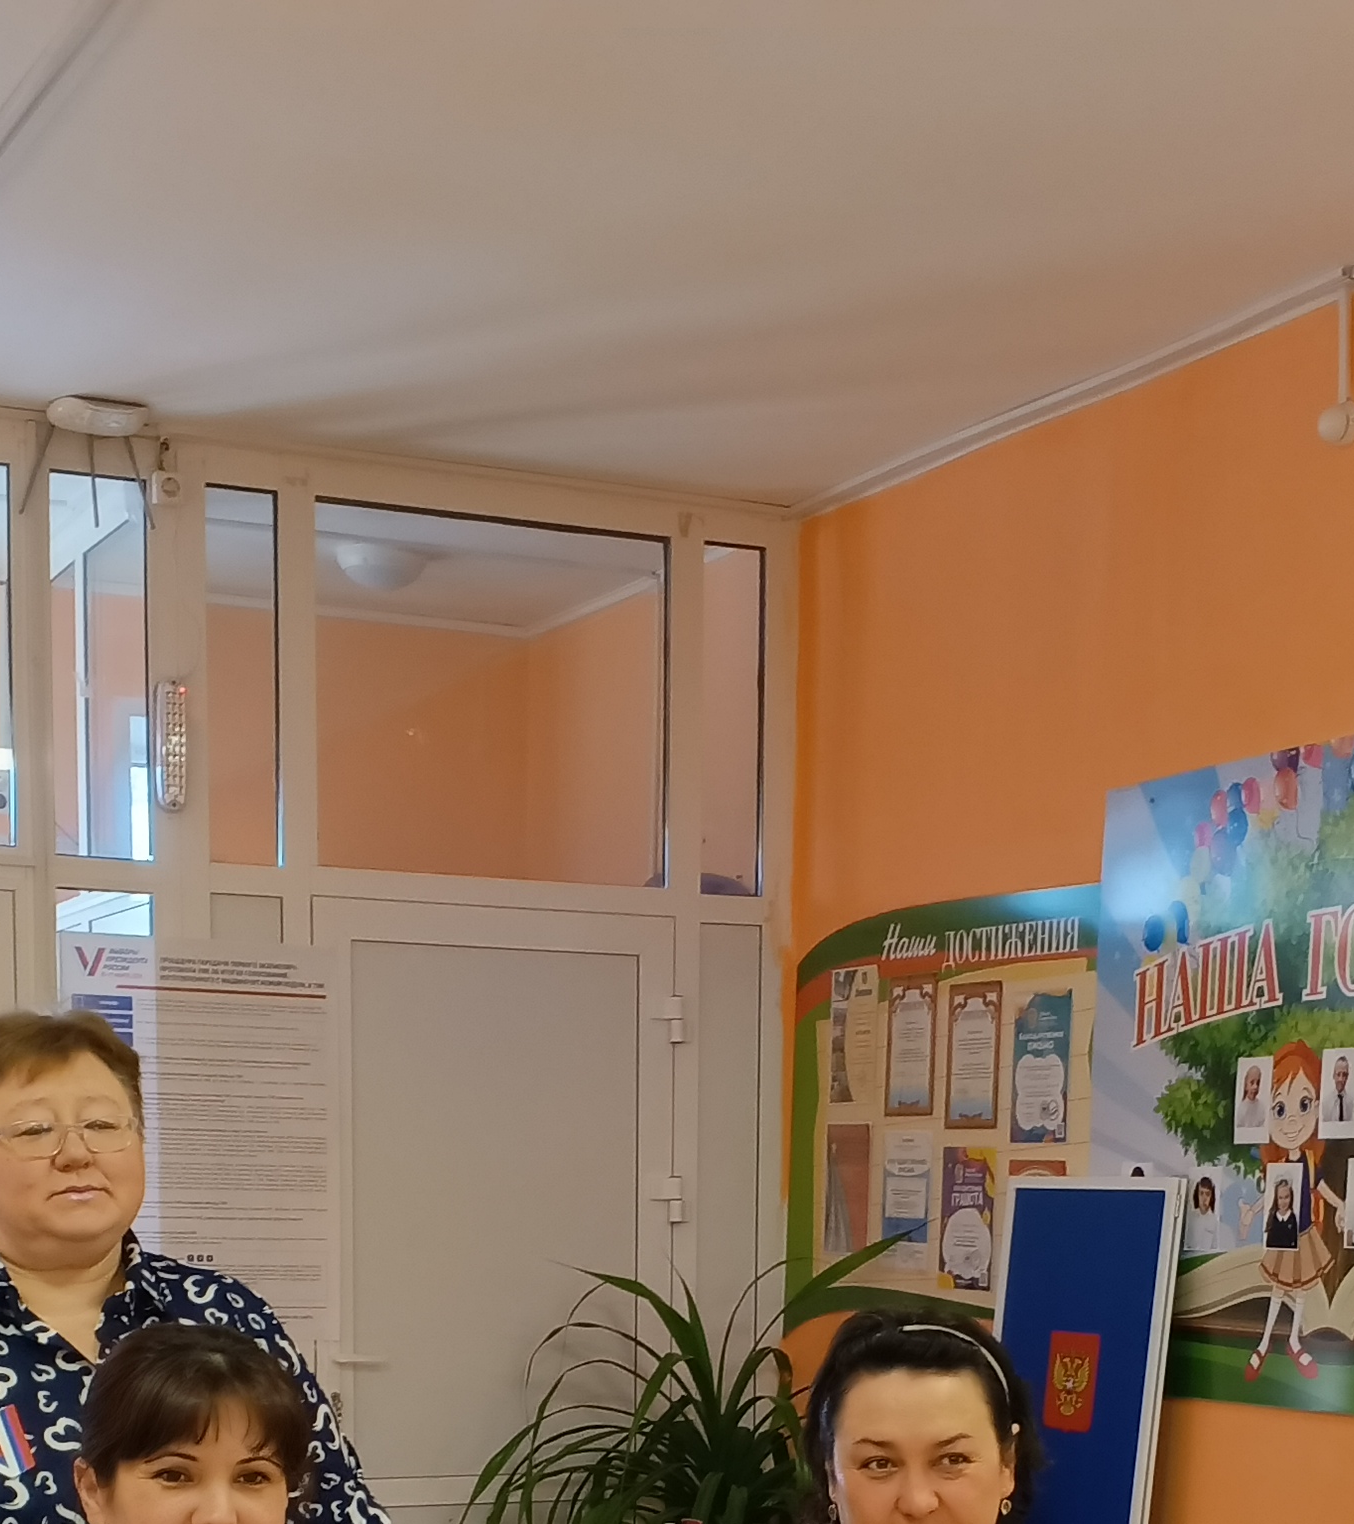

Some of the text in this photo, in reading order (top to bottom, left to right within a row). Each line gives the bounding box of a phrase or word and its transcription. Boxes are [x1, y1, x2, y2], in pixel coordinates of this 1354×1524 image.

[881, 916, 1081, 974] Наши ДОСТИЖЕНИЯ
[1132, 918, 1283, 1048] НАША
